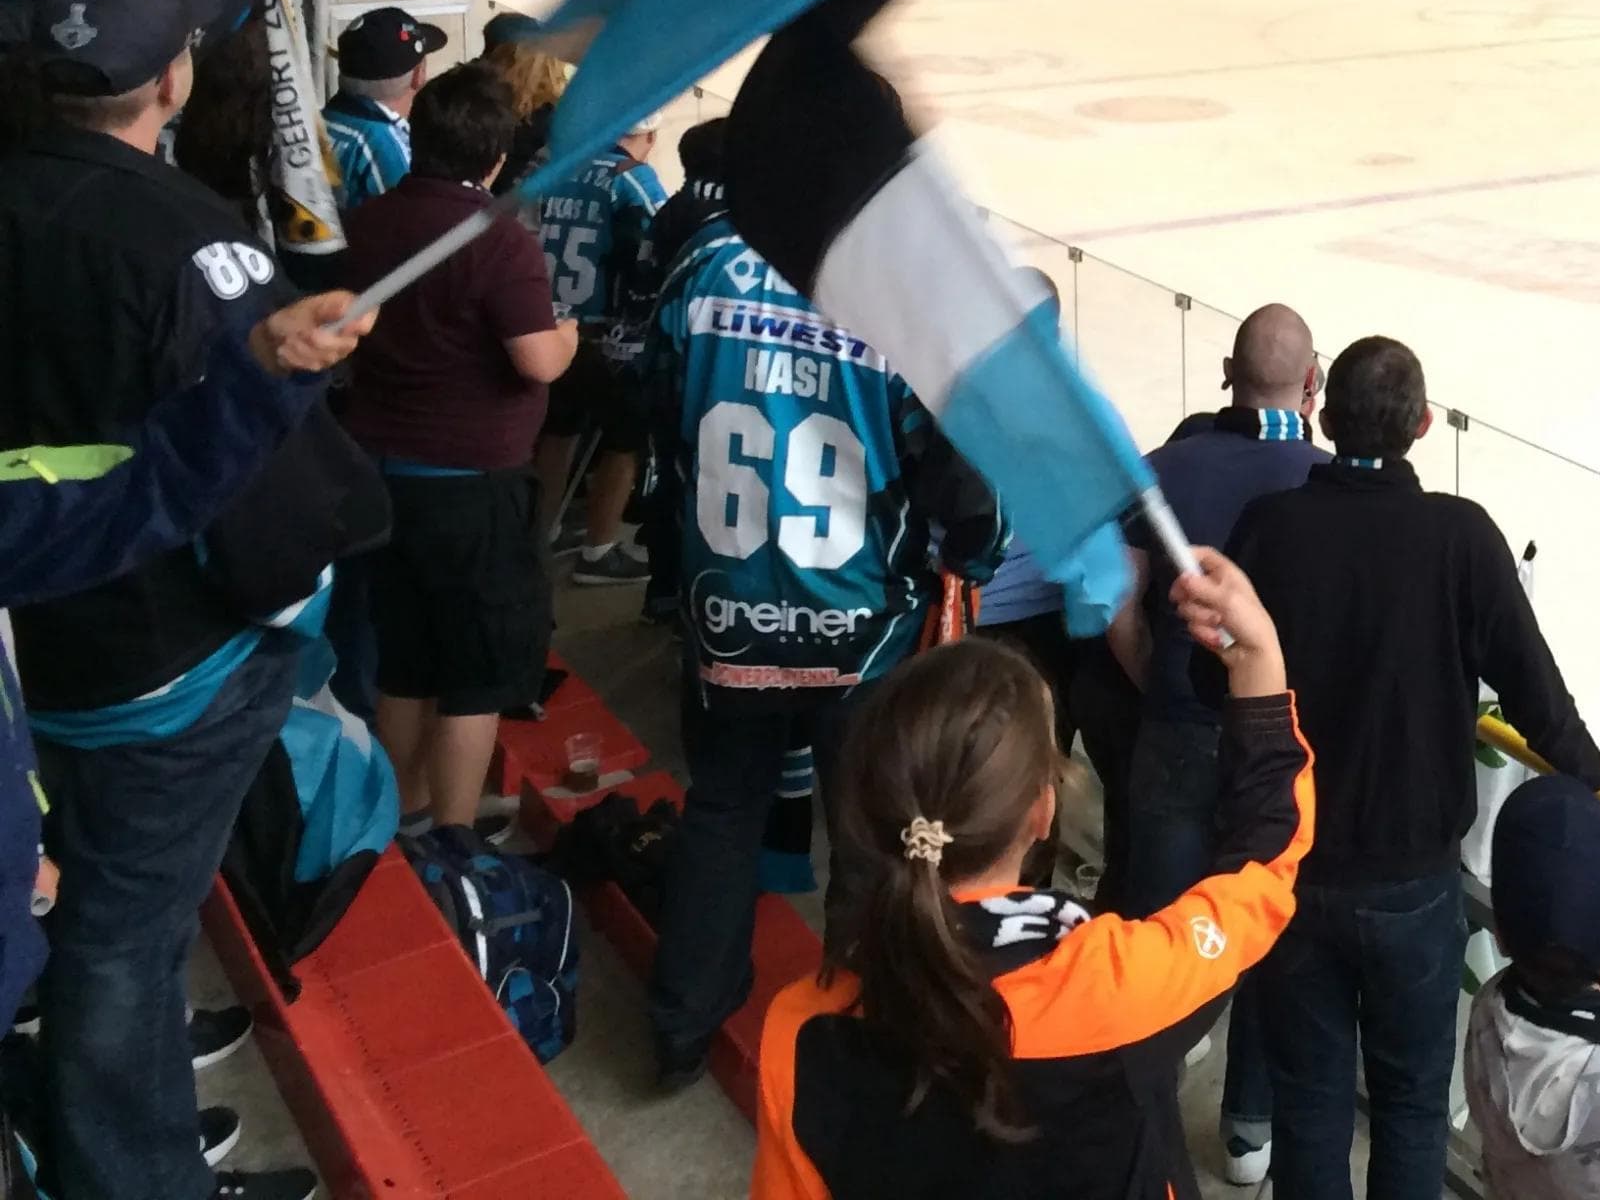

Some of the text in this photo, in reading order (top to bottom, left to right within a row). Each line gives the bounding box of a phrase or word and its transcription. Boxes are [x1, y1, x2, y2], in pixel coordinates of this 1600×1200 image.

[744, 347, 832, 403] HASI
[696, 400, 867, 571] 69
[704, 595, 874, 638] greiner
